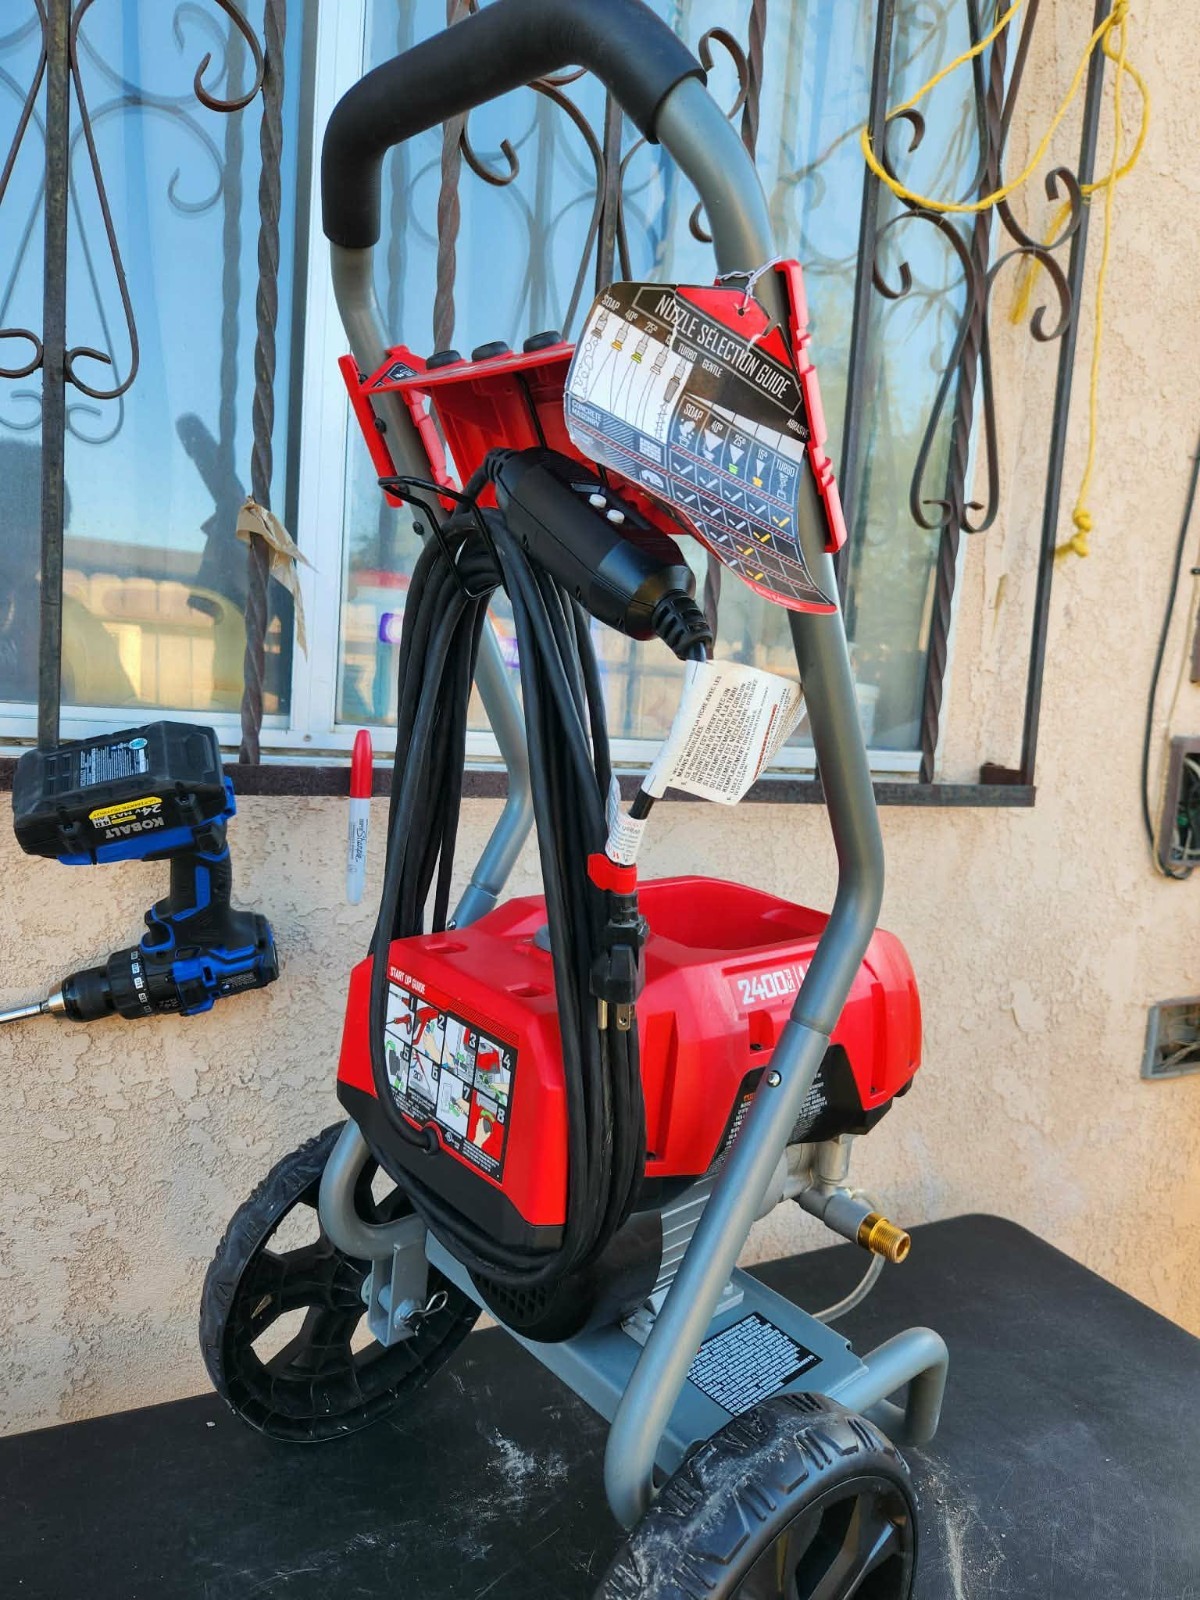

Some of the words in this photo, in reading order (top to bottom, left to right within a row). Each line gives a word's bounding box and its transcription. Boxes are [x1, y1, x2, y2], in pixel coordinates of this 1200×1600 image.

[601, 295, 621, 310] SOAP
[677, 343, 698, 361] TURBO
[655, 294, 699, 337] NOZZLE
[753, 364, 790, 399] GUIDE
[702, 359, 723, 377] GENTLE
[572, 400, 602, 421] CONCRETE
[683, 403, 704, 420] SOAP
[776, 459, 795, 474] TURBO
[687, 746, 702, 771] PRODUIT
[699, 734, 708, 746] EST
[715, 696, 725, 713] AVEC
[722, 687, 730, 697] UN
[707, 742, 718, 759] DANS
[715, 734, 722, 742] LA
[708, 725, 733, 772] REMPLACEMENT
[734, 708, 741, 717] LA
[676, 757, 688, 777] MAINS
[105, 816, 164, 838] KOBALT
[355, 828, 365, 859] Sharpie
[390, 966, 404, 981] START
[404, 975, 411, 985] UP
[412, 978, 425, 994] GUIDE
[737, 970, 789, 1004] 2400
[437, 1013, 444, 1031] 2
[468, 1033, 477, 1050] 3
[403, 1046, 410, 1060] 5
[503, 1053, 511, 1071] 4
[432, 1065, 439, 1079] 6
[462, 1086, 470, 1100] 7
[496, 1107, 505, 1124] 8
